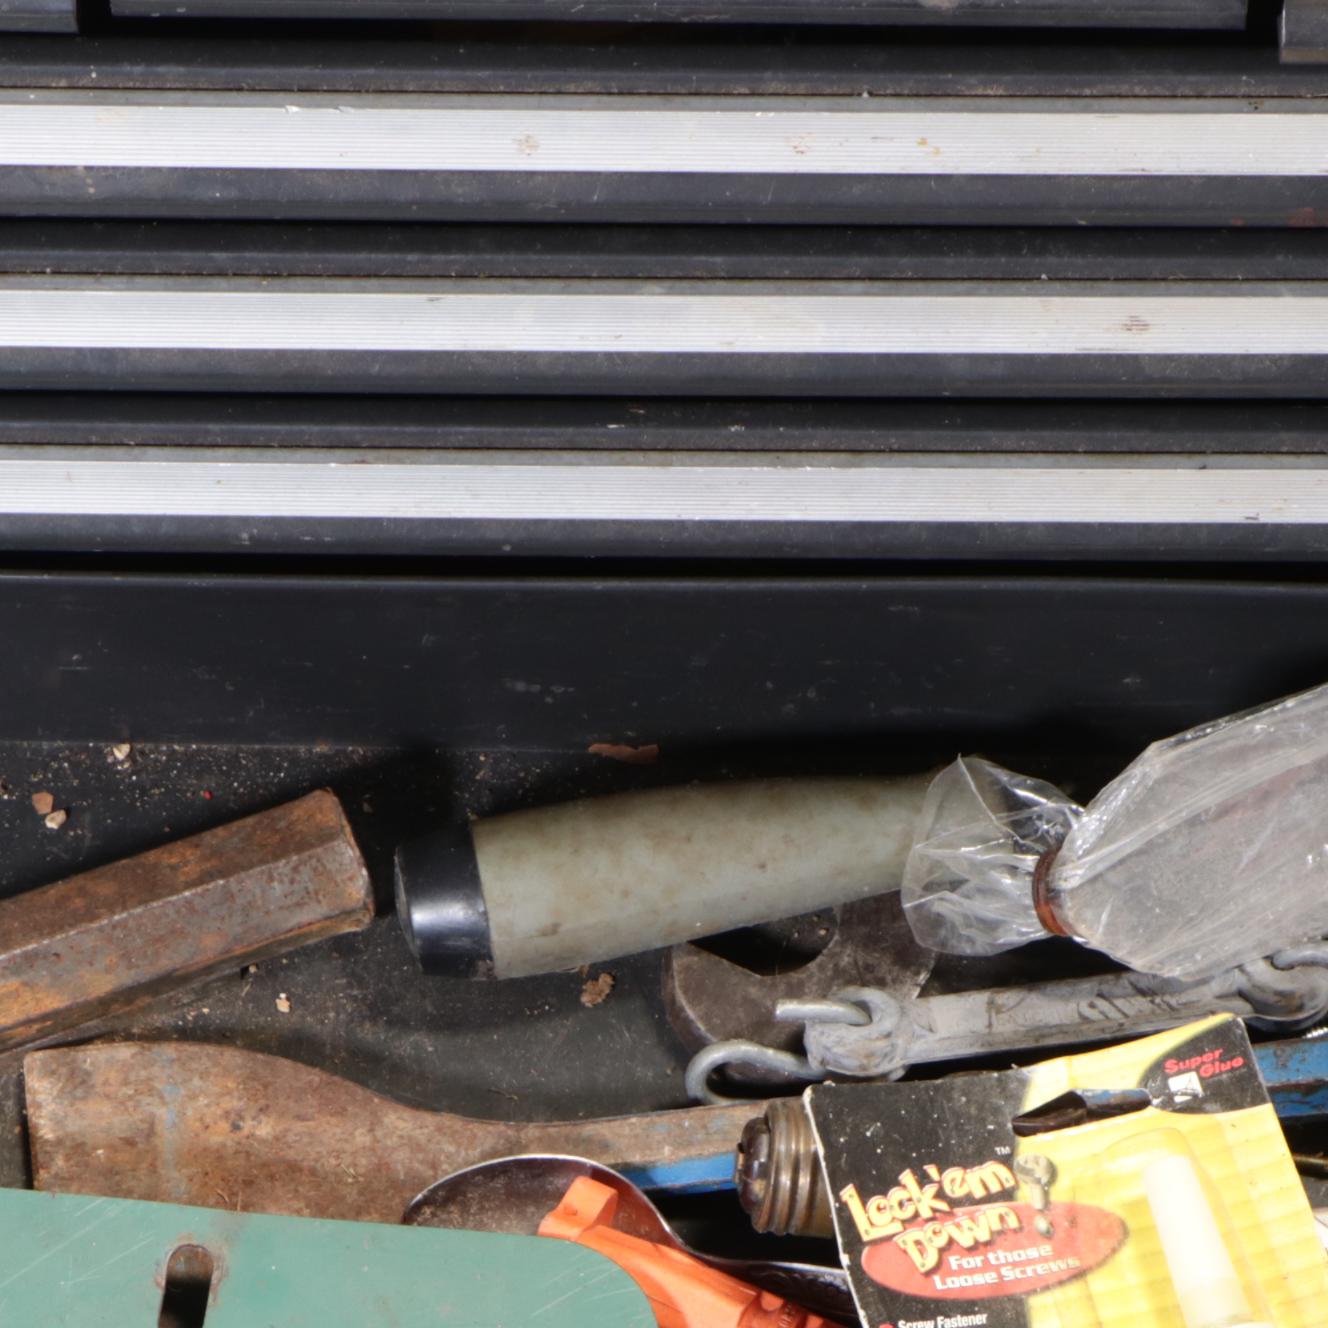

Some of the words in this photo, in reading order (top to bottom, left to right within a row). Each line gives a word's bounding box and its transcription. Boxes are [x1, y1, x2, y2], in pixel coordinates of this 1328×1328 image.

[1164, 1048, 1223, 1073] Super
[1199, 1055, 1244, 1078] Glue
[894, 1205, 1022, 1274] Down
[948, 1253, 987, 1272] For
[990, 1242, 1053, 1265] those
[934, 1269, 998, 1291] Loose
[1001, 1256, 1081, 1282] Screws
